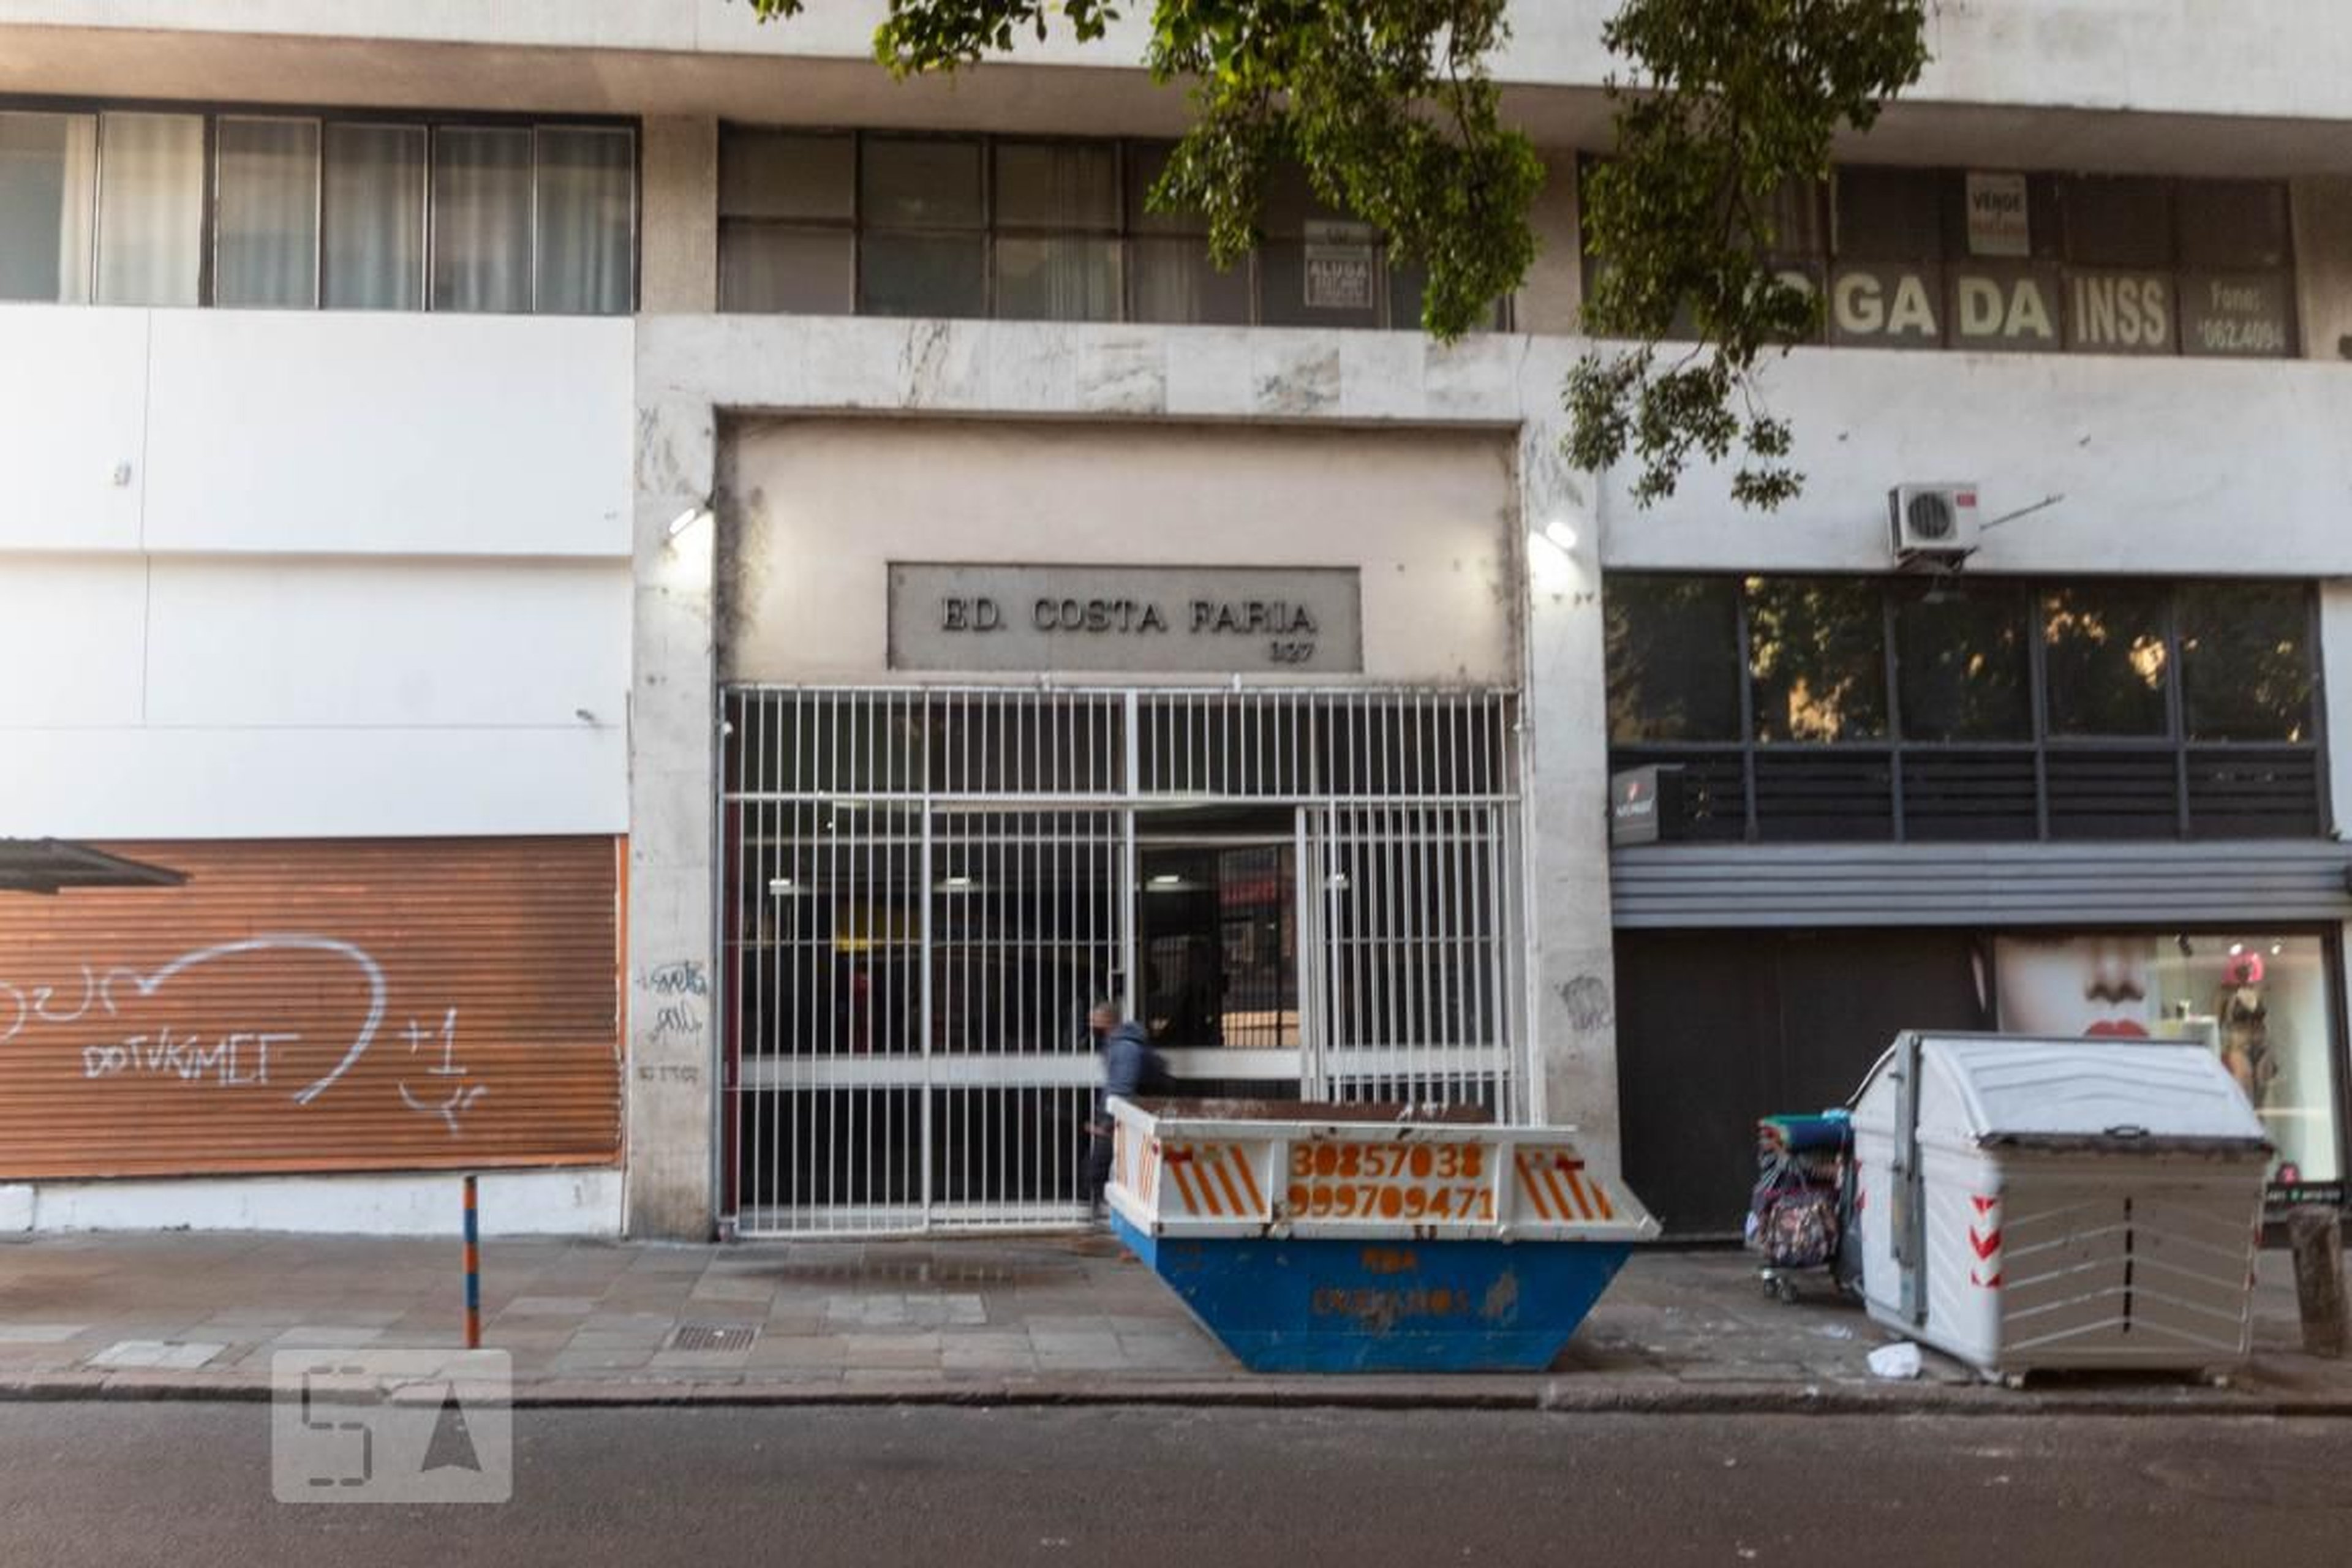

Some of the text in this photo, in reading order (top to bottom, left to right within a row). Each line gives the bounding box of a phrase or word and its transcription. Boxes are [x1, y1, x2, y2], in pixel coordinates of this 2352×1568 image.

[2076, 275, 2167, 345] INSS
[1032, 598, 1168, 633] COSTA
[1189, 600, 1317, 633] FARIA
[1269, 640, 1316, 665] 127
[1292, 1143, 1482, 1177] 30857038
[1287, 1184, 1494, 1219] 999709471
